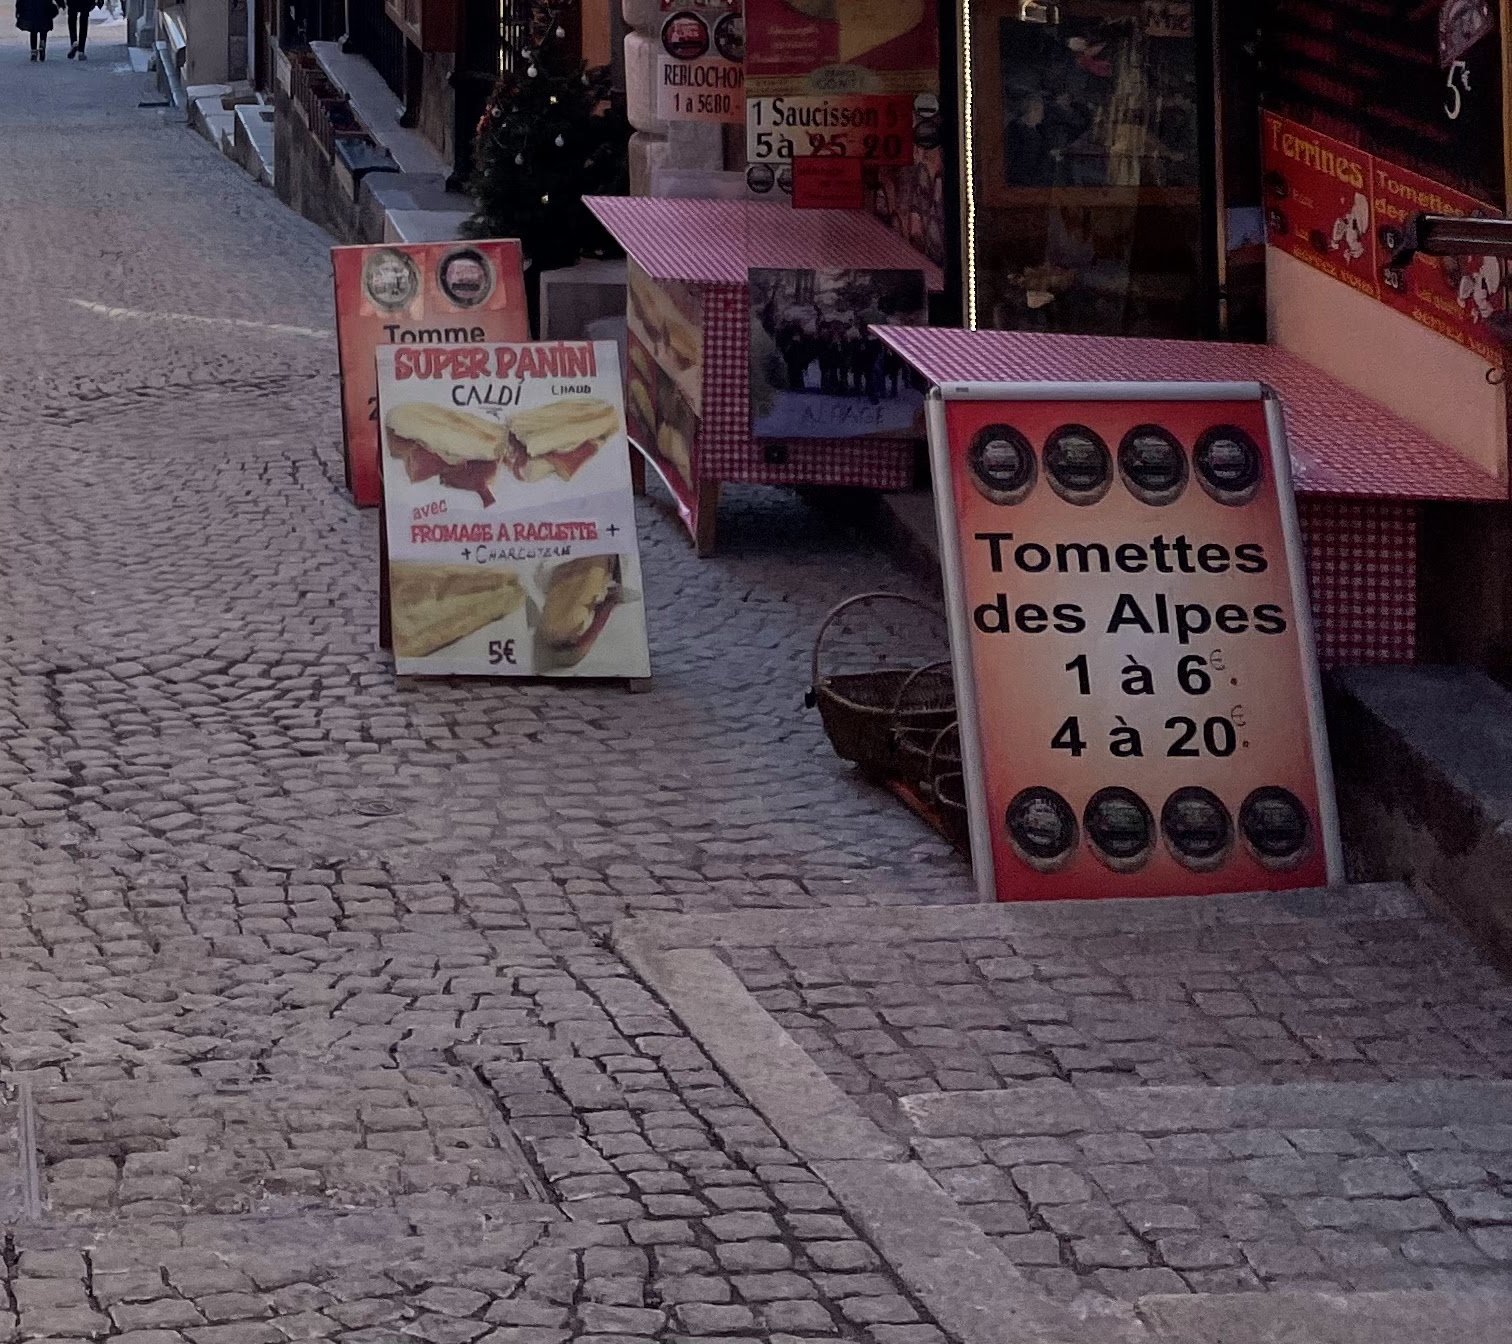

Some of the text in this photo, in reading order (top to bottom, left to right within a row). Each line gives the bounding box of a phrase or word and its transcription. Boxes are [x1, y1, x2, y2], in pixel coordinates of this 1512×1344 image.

[752, 101, 762, 126] 1
[772, 97, 878, 128] Saucisson
[382, 324, 486, 343] Tomme
[394, 340, 597, 380] SUPER PANINI
[412, 498, 448, 521] avec
[411, 522, 494, 544] FROMAGE
[497, 522, 511, 542] A
[512, 520, 598, 542] RACLETTE
[974, 532, 1268, 574] Tomettes
[973, 592, 1288, 645] des Alpes
[488, 638, 517, 666] 5€
[1065, 654, 1091, 695] 1
[1120, 654, 1155, 696] à
[1050, 715, 1087, 758] 4
[1108, 714, 1144, 758] à
